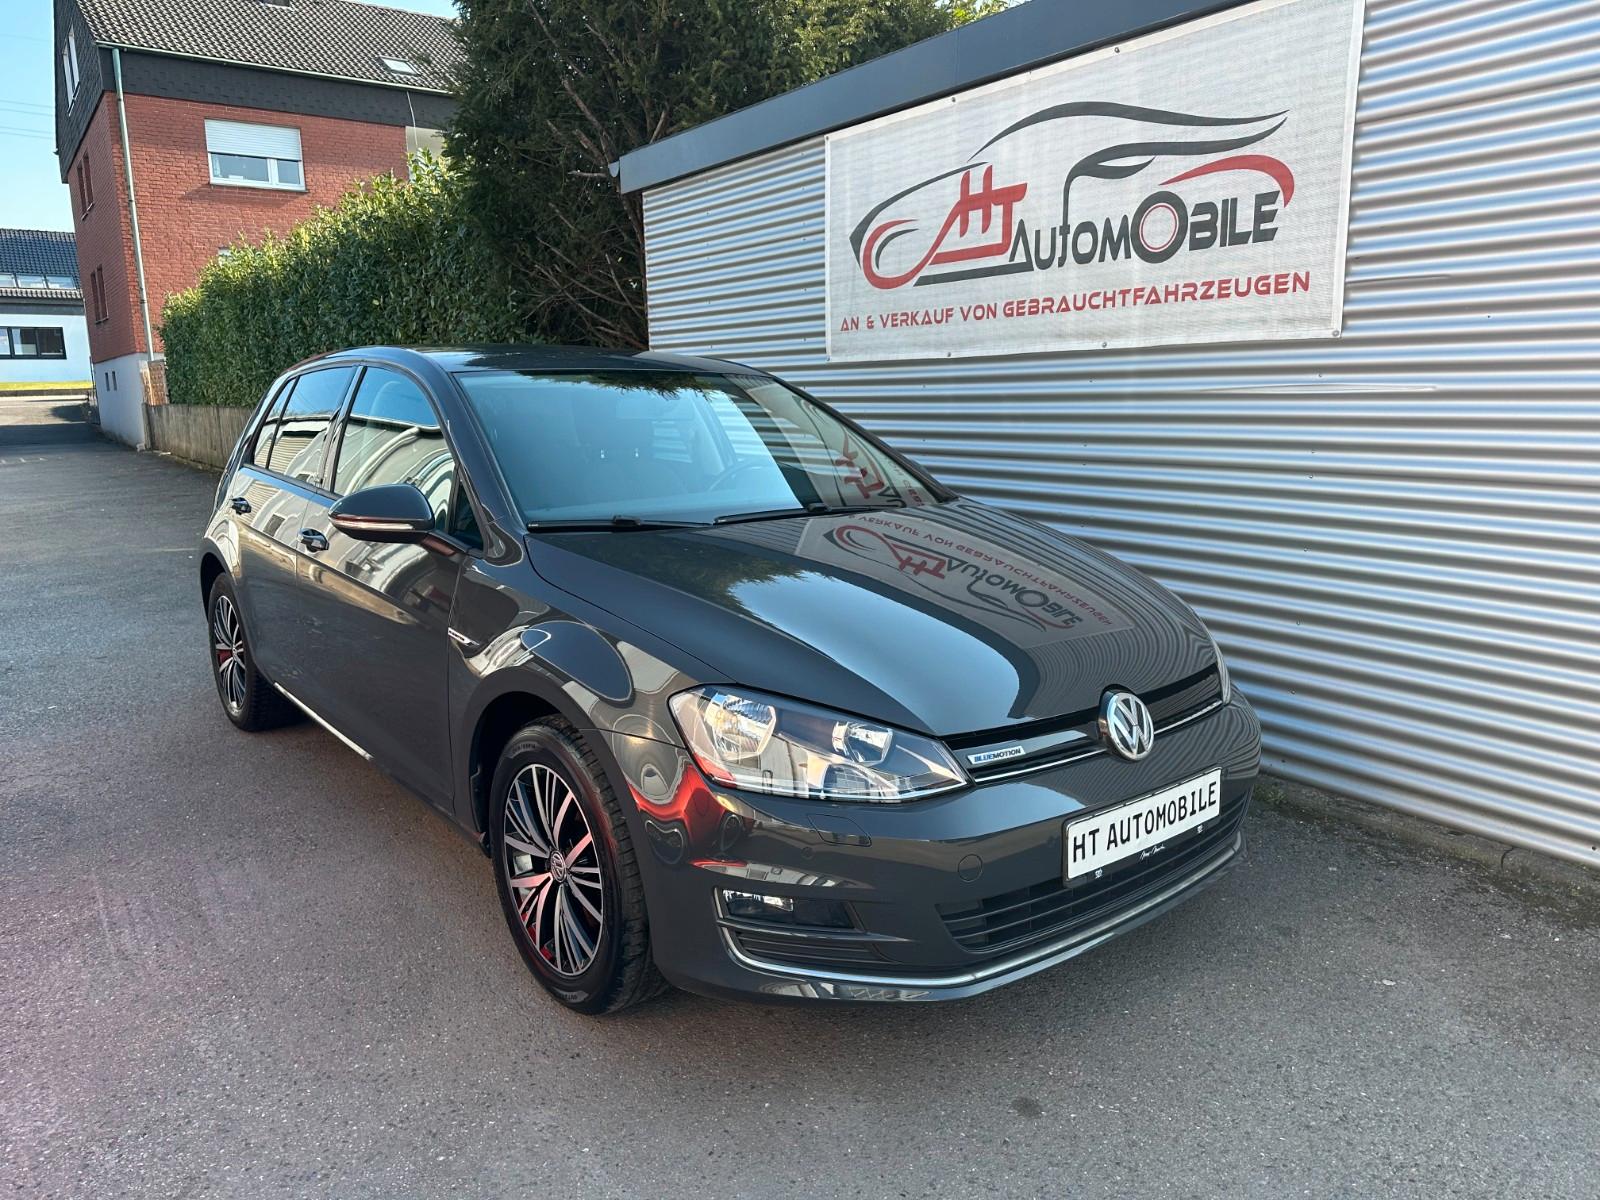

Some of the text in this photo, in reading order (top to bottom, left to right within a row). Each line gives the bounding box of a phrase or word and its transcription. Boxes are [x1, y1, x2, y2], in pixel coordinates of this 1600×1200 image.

[840, 271, 1310, 332] AN & VERKAUF VON GEBRAUCHTFAHRZEUGEN
[974, 747, 1022, 762] BLUEMOTION
[1072, 781, 1217, 863] HT AUTOMOBILE
